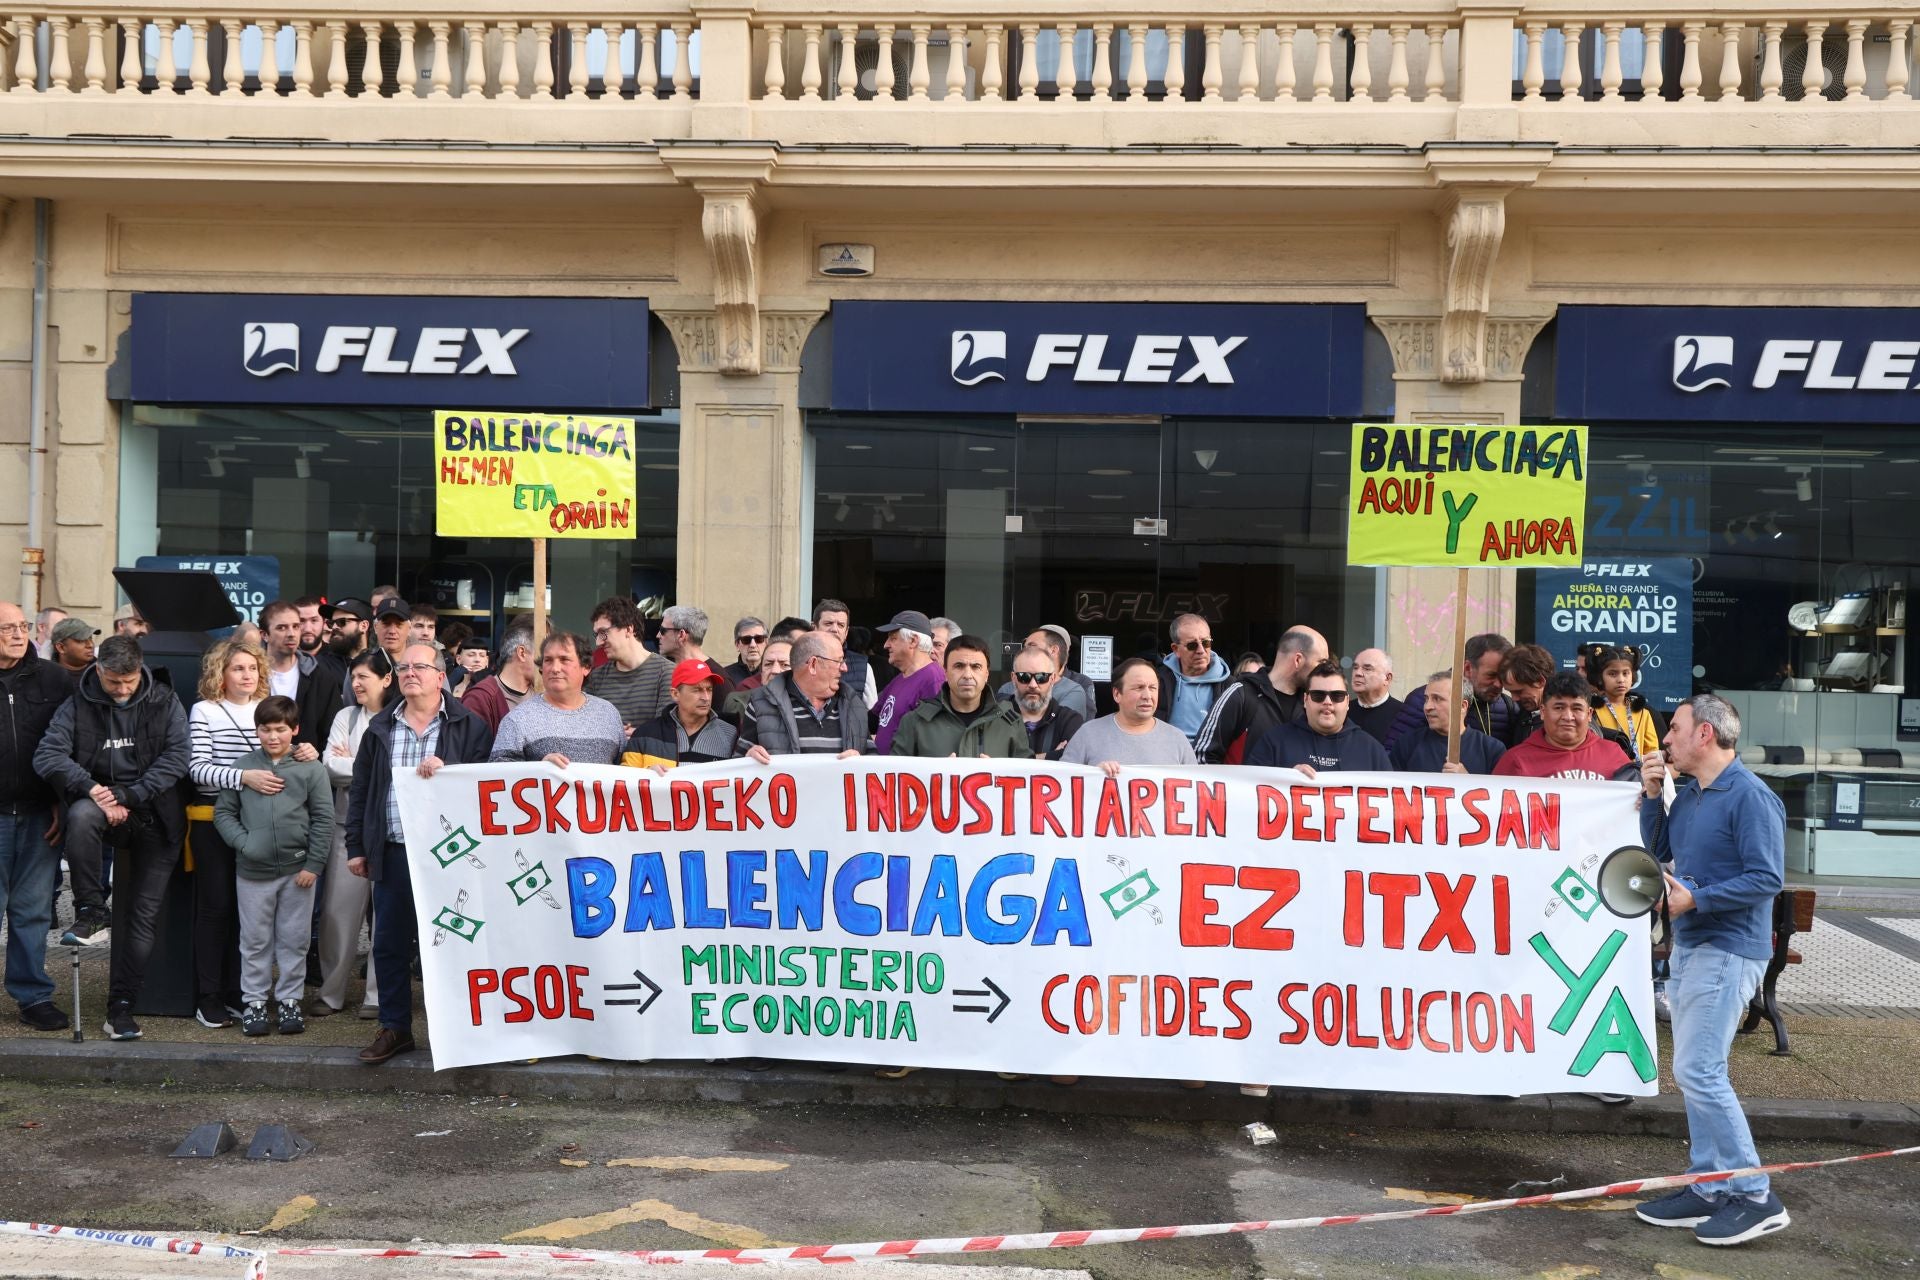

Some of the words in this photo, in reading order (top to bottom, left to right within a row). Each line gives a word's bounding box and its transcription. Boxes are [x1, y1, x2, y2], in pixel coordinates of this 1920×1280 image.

[315, 326, 531, 375] FLEX
[1026, 333, 1248, 383] FLEX
[1752, 340, 1920, 389] FLE
[441, 456, 514, 486] HEMEN
[1360, 427, 1583, 481] BALENCIAGA
[513, 483, 559, 511] ETA
[1442, 490, 1479, 554] Y
[1480, 517, 1577, 562] AHORA
[221, 582, 248, 590] ANDE
[1569, 583, 1602, 593] SUEÑA
[1605, 585, 1617, 593] EN
[1619, 585, 1659, 593] GRANDE
[1598, 564, 1652, 577] FLEX
[243, 592, 265, 606] LO
[1106, 592, 1229, 622] FLEX
[1552, 595, 1632, 609] AHORRA
[1636, 596, 1650, 609] A
[1654, 596, 1677, 610] LO
[1551, 610, 1677, 634] GRANDE
[1551, 769, 1606, 781] ARVARD
[477, 773, 798, 836] ESKUALDEKO
[843, 772, 1227, 838] INDUSTRIAREN
[1257, 784, 1561, 851] DEFENTSAN
[565, 849, 1092, 945] BALENCIAGA
[1179, 863, 1301, 951] EZ
[1343, 870, 1511, 955] ITXI
[682, 945, 945, 994] MINISTERIO
[468, 965, 595, 1026] PSOE
[691, 993, 918, 1042] ECONOMIA
[1041, 973, 1253, 1040] COFIDES
[1279, 982, 1535, 1053] SOLUCION
[131, 1234, 156, 1248] NO
